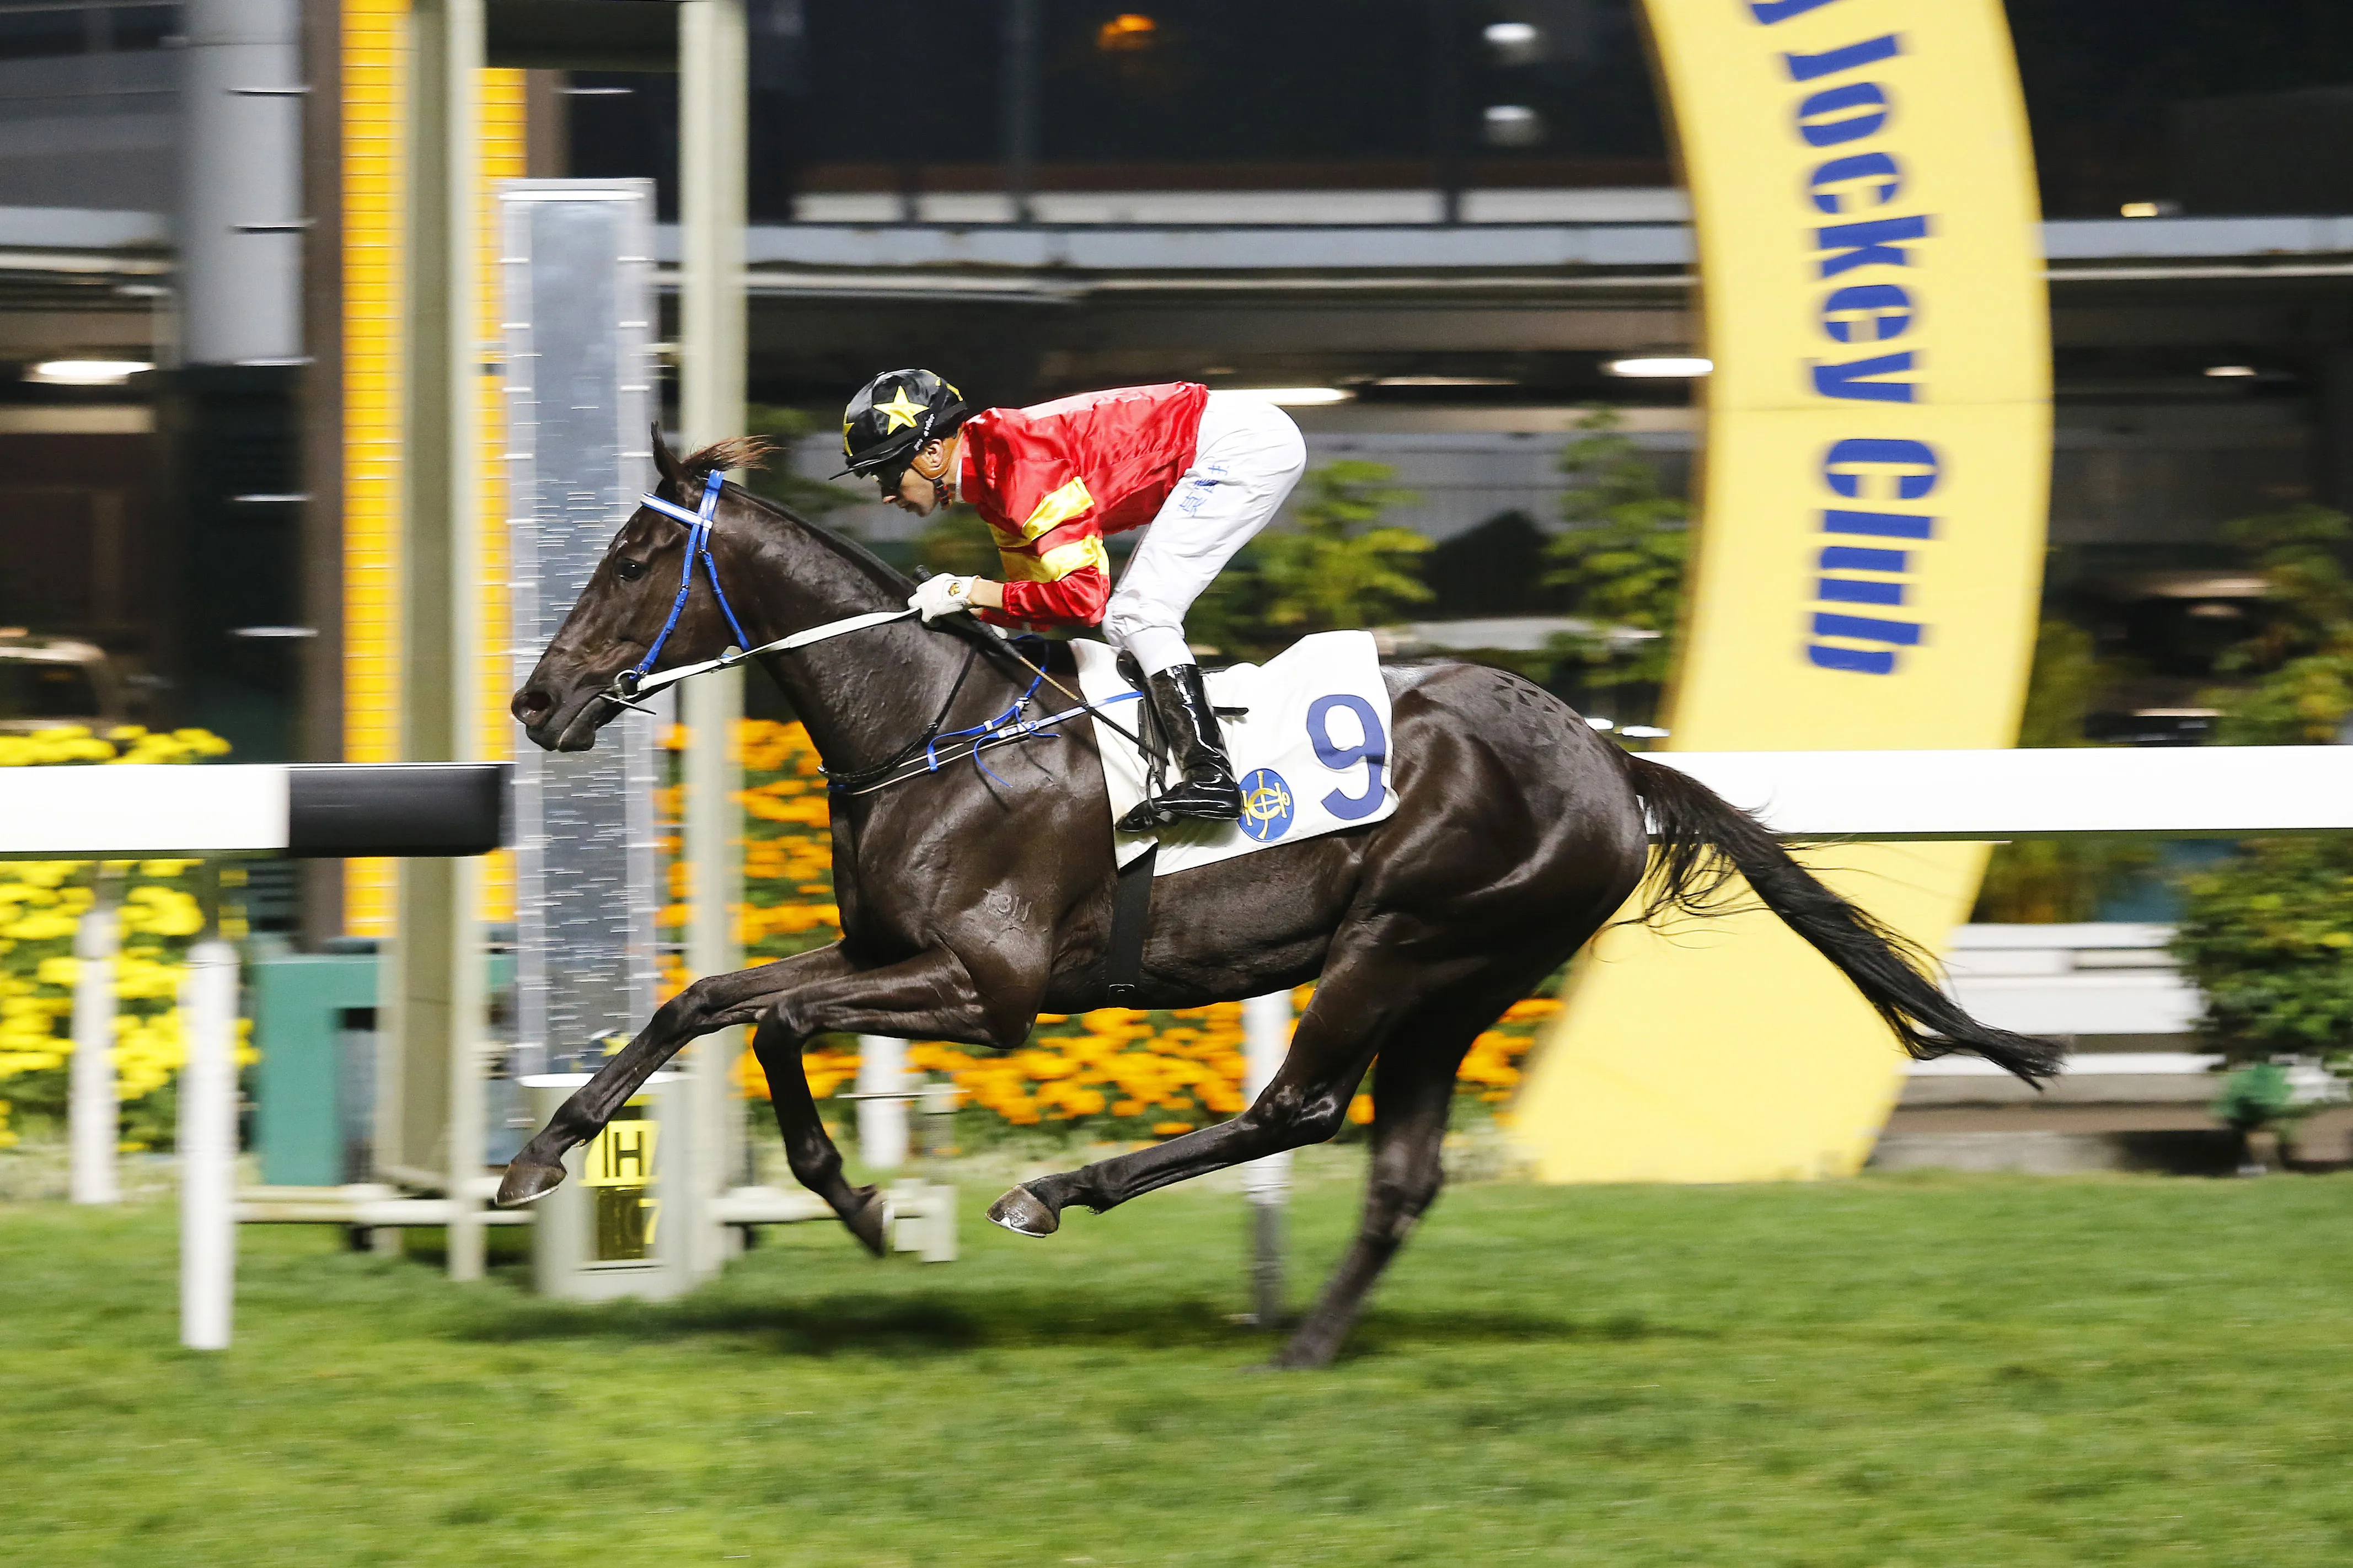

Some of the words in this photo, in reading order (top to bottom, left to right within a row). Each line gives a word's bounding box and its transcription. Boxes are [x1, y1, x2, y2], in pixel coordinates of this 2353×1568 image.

[1784, 34, 1930, 403] Jockey
[1807, 438, 1938, 675] Club
[1306, 694, 1386, 820] 9
